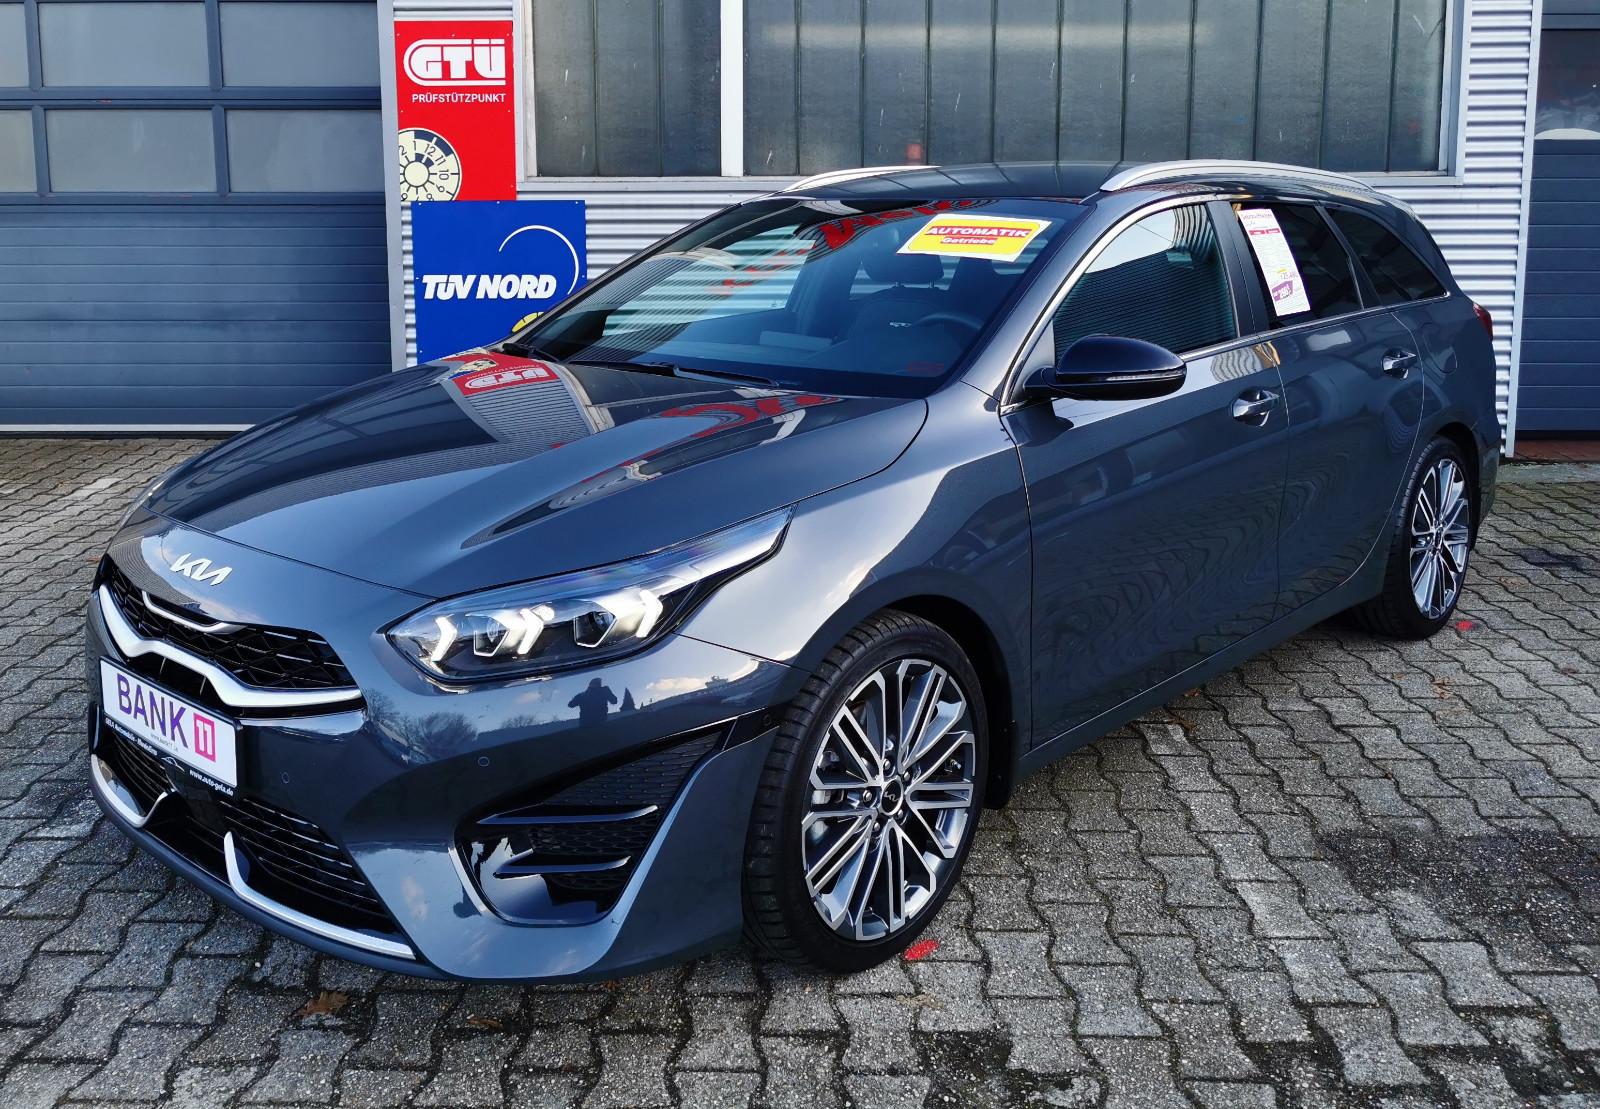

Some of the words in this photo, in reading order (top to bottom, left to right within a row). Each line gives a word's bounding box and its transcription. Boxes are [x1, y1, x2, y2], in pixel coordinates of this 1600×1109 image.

[405, 39, 506, 81] GTÜ
[411, 92, 506, 104] PRÜFSTÜTZPUNKT
[424, 144, 436, 157] 12
[435, 155, 446, 166] 11
[438, 169, 450, 181] 10
[926, 226, 1030, 238] AUTOMATIK
[941, 236, 997, 246] Getriebe
[422, 274, 476, 300] TÜV
[476, 274, 557, 300] NORD
[170, 552, 233, 586] KIA
[117, 673, 189, 749] BANK
[195, 716, 214, 758] 11
